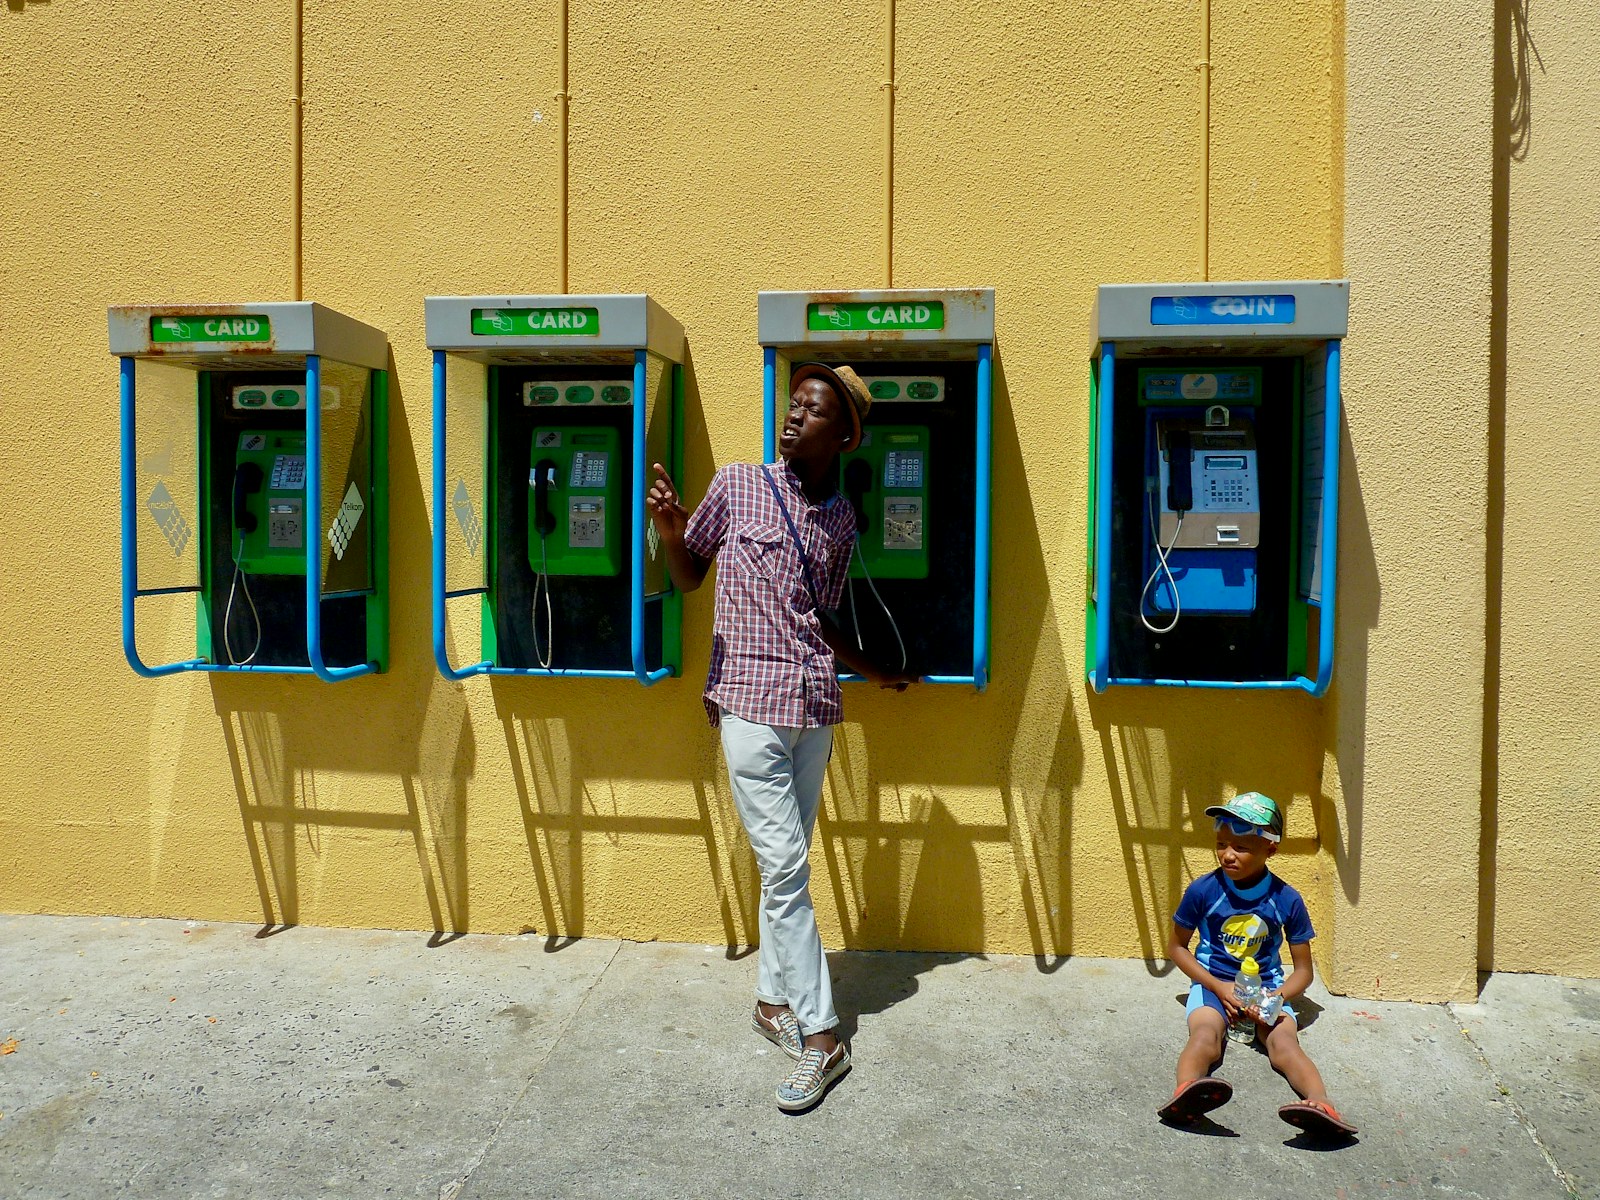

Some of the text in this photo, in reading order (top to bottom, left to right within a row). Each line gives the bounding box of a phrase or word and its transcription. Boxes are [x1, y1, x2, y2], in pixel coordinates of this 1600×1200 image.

[866, 305, 931, 325] CARD
[1209, 297, 1275, 317] COIN
[203, 318, 260, 337] CARD
[527, 311, 588, 330] CARD
[343, 502, 363, 511] Telkom
